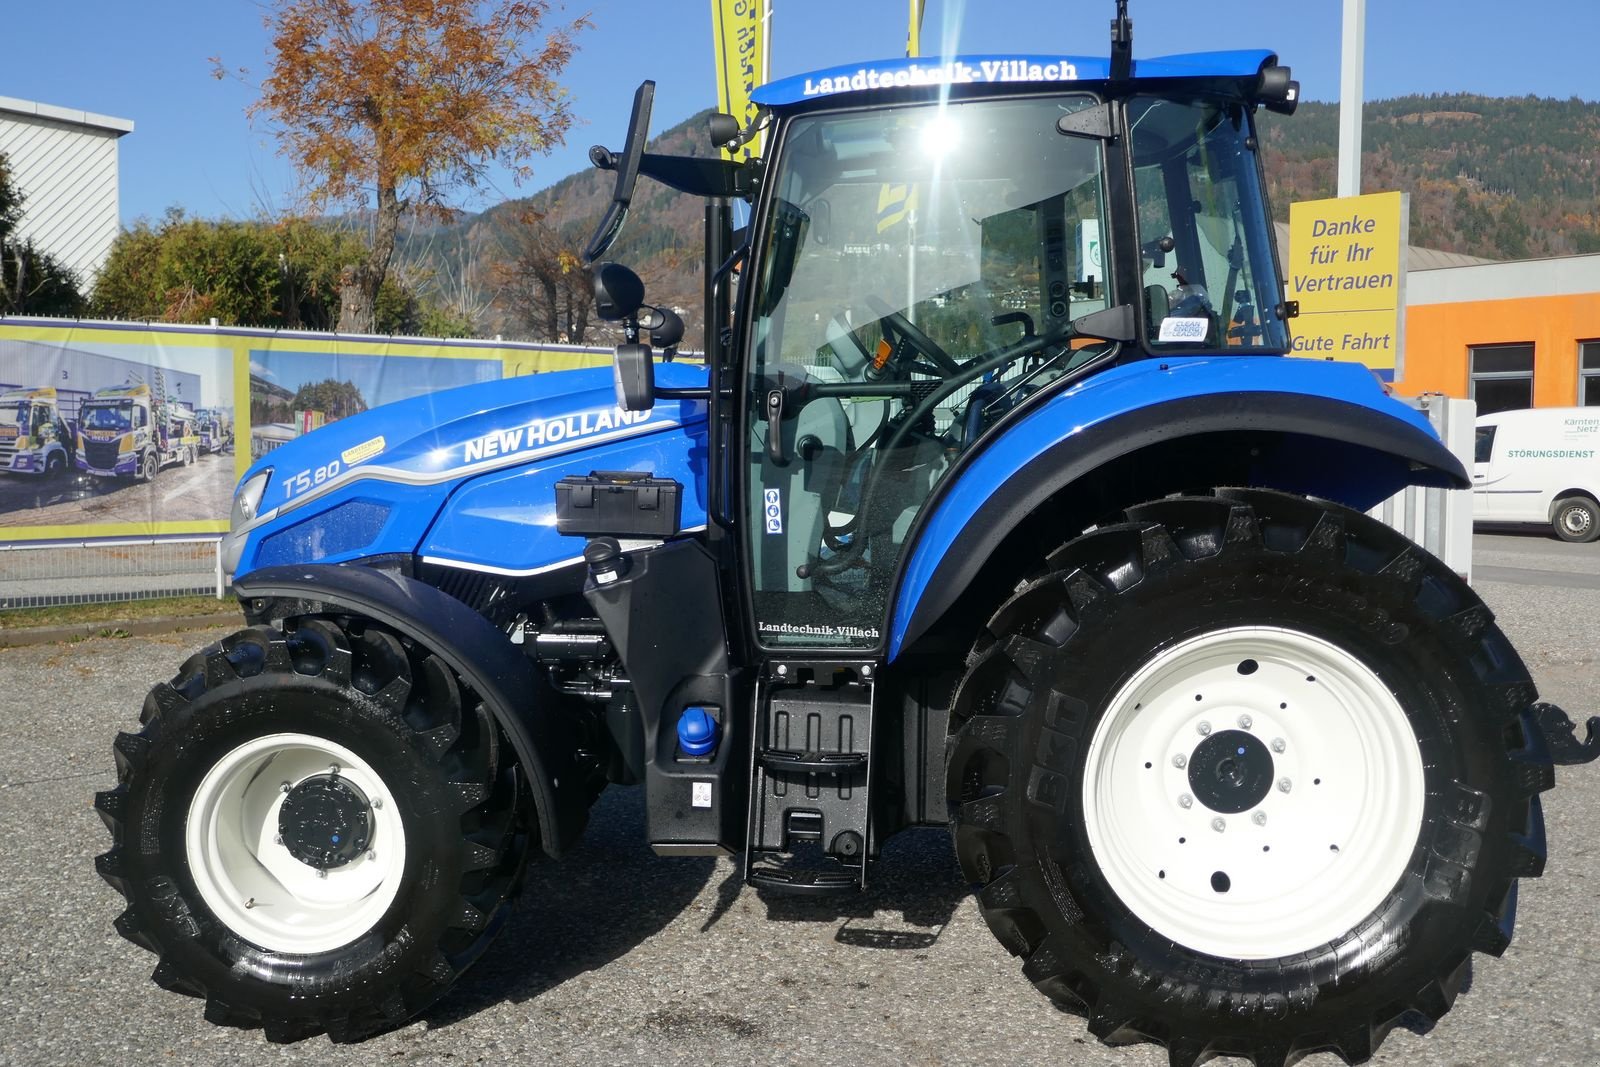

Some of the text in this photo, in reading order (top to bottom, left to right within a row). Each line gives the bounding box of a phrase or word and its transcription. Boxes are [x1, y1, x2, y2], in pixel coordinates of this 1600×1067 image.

[803, 60, 1078, 96] Landtechnik-Villach
[1312, 214, 1376, 238] Danke
[1309, 243, 1374, 265] für Ihr
[1293, 271, 1394, 293] Vertrauen
[1291, 332, 1391, 352] Gute Fahrt
[464, 405, 652, 463] NEW HOLLAND
[1576, 425, 1599, 433] Netz
[1508, 448, 1595, 459] STÖRUNGSDIENST
[282, 459, 340, 499] T5.80
[758, 621, 880, 638] Landtechnik-Villach
